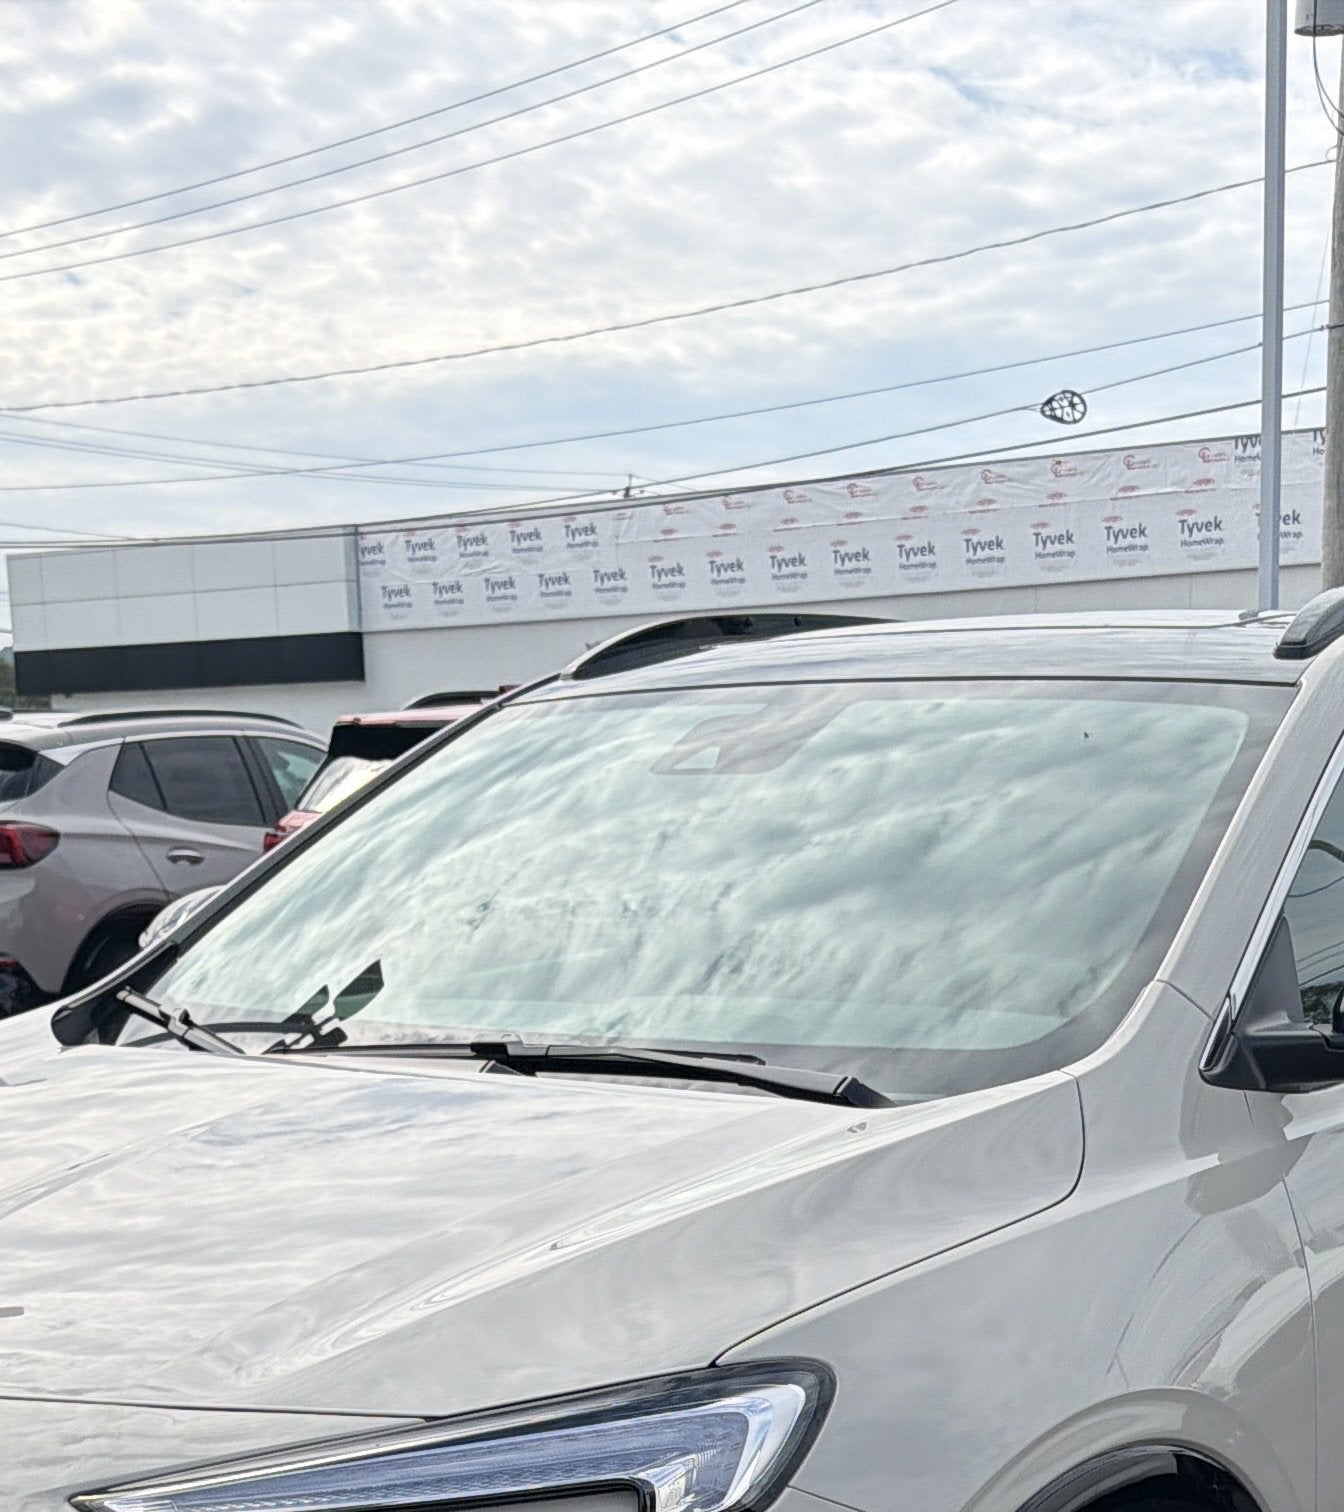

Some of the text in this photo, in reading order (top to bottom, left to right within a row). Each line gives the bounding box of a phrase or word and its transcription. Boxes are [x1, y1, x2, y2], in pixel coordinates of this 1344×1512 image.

[509, 527, 543, 544] Tyvek
[564, 522, 598, 541] Tyvek
[1104, 521, 1149, 545] Tyvek
[1178, 514, 1223, 538] Tyvek
[405, 538, 437, 556] Tyvek
[457, 533, 489, 550] Tyvek
[964, 535, 1005, 557] Tyvek
[1033, 528, 1075, 551] Tyvek
[360, 541, 385, 558] yvek
[832, 547, 871, 567] Tyvek
[896, 541, 937, 563] Tyvek
[708, 557, 745, 577] Tyvek
[769, 551, 808, 572] Tyvek
[538, 571, 572, 590] Tyvek
[593, 567, 628, 586] Tyvek
[649, 562, 686, 581] Tyvek
[381, 584, 413, 601] Tyvek
[432, 580, 463, 598] Tyvek
[484, 576, 516, 595] Tyvek
